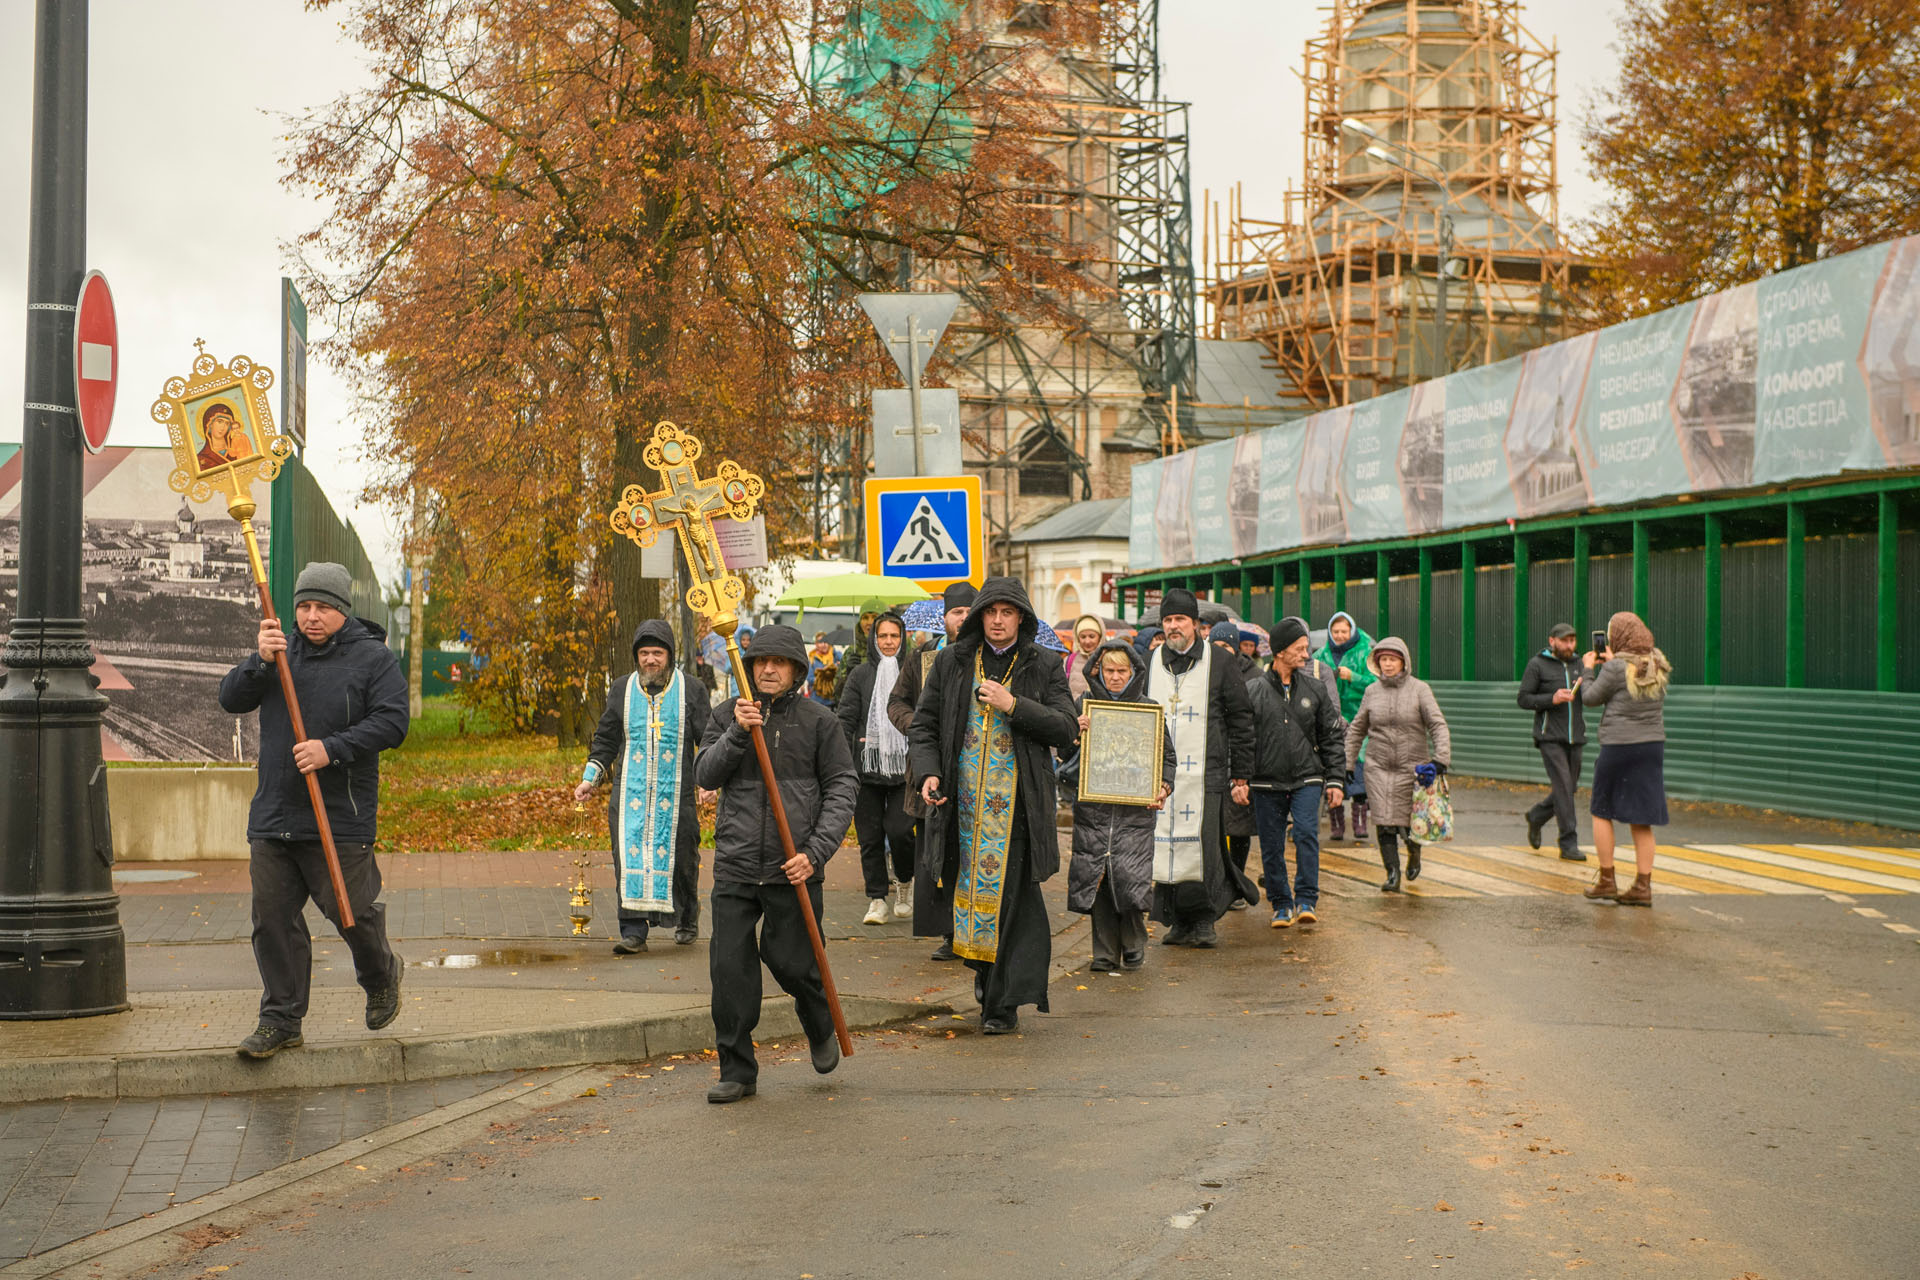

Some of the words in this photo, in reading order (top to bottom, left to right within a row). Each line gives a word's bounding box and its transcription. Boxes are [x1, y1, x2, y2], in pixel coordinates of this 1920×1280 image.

[1764, 328, 1783, 352] НА
[1763, 360, 1845, 398] КОМФОРТ
[1599, 401, 1664, 431] РЕЗУЛЬТАТ
[1763, 399, 1848, 431] НАВСЕГДА
[1599, 436, 1657, 464] НАВСЕГДА
